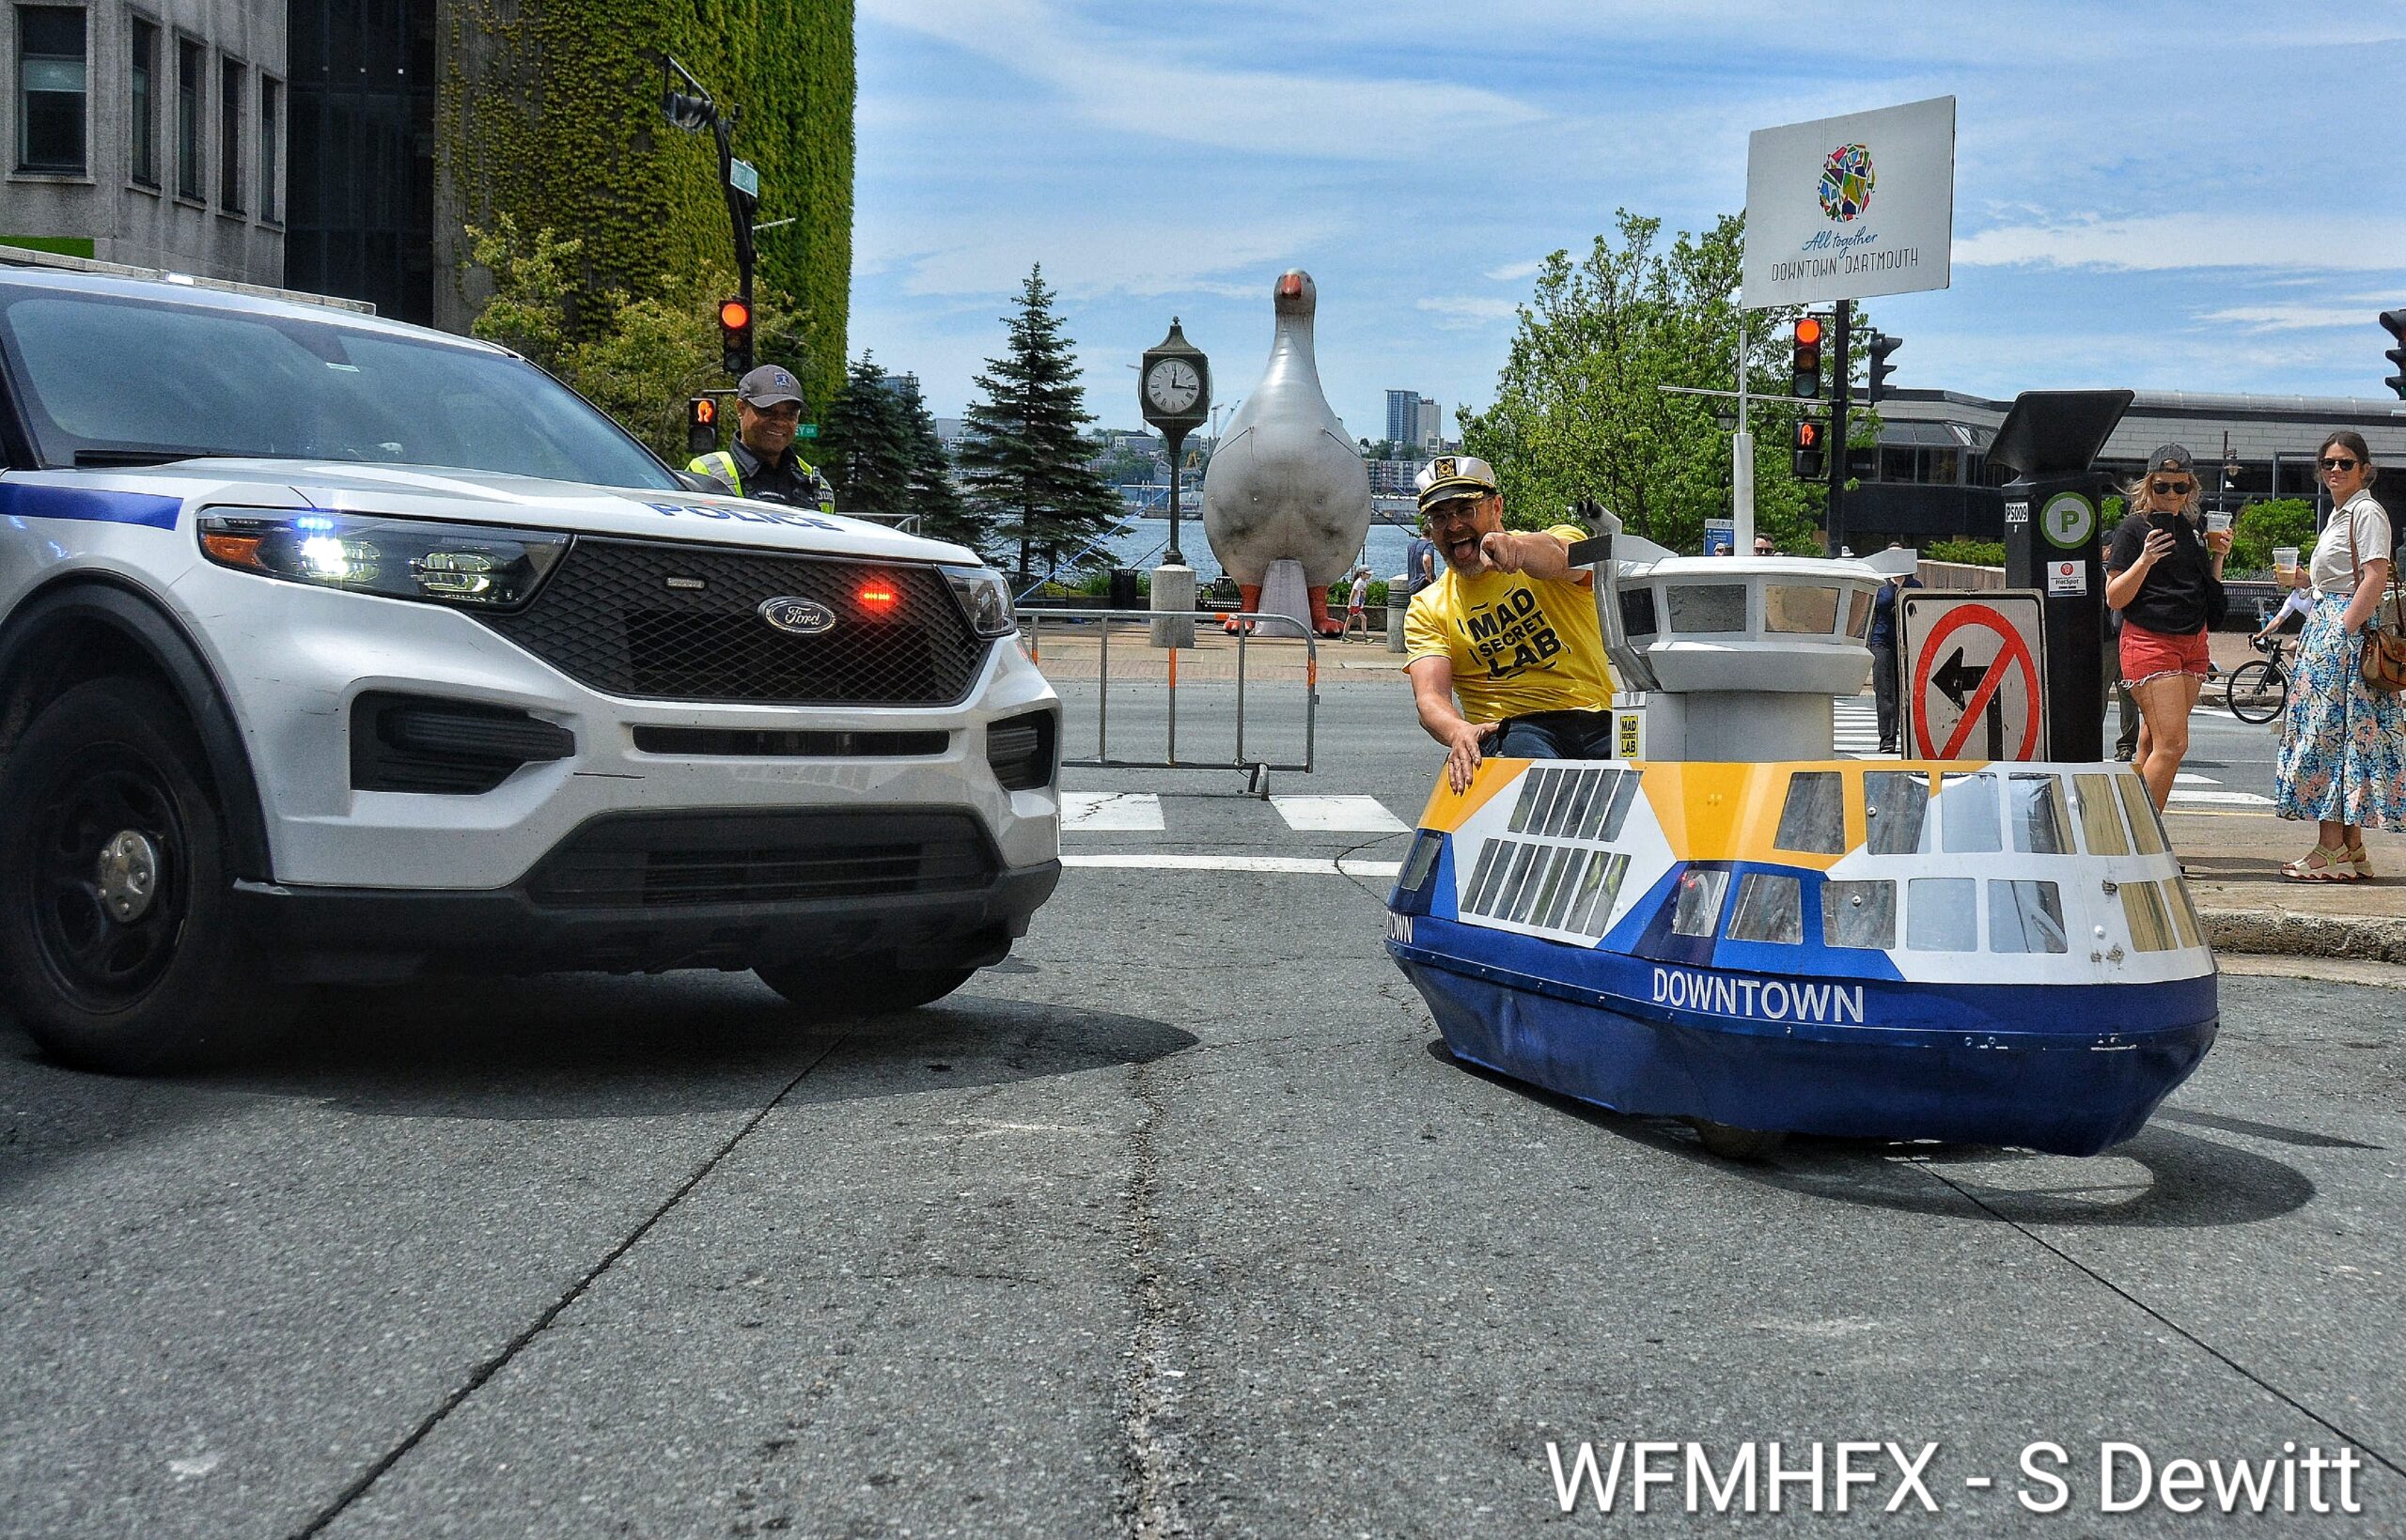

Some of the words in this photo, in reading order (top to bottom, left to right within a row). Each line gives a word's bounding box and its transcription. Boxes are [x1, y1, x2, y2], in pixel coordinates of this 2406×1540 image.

[1802, 229, 1832, 251] All
[1832, 226, 1878, 258] together
[1772, 257, 1837, 282] DOWNTOWN
[1845, 247, 1918, 274] DARTMOUTH
[641, 502, 846, 532] POLICE
[2060, 510, 2080, 533] P
[785, 606, 821, 626] Ford
[1467, 588, 1536, 643] MAD
[1478, 610, 1545, 657] SECRET
[1487, 628, 1562, 677] LAB
[1621, 720, 1636, 731] MAD
[1621, 740, 1635, 753] LAB
[1652, 967, 1864, 1023] DOWNTOWN
